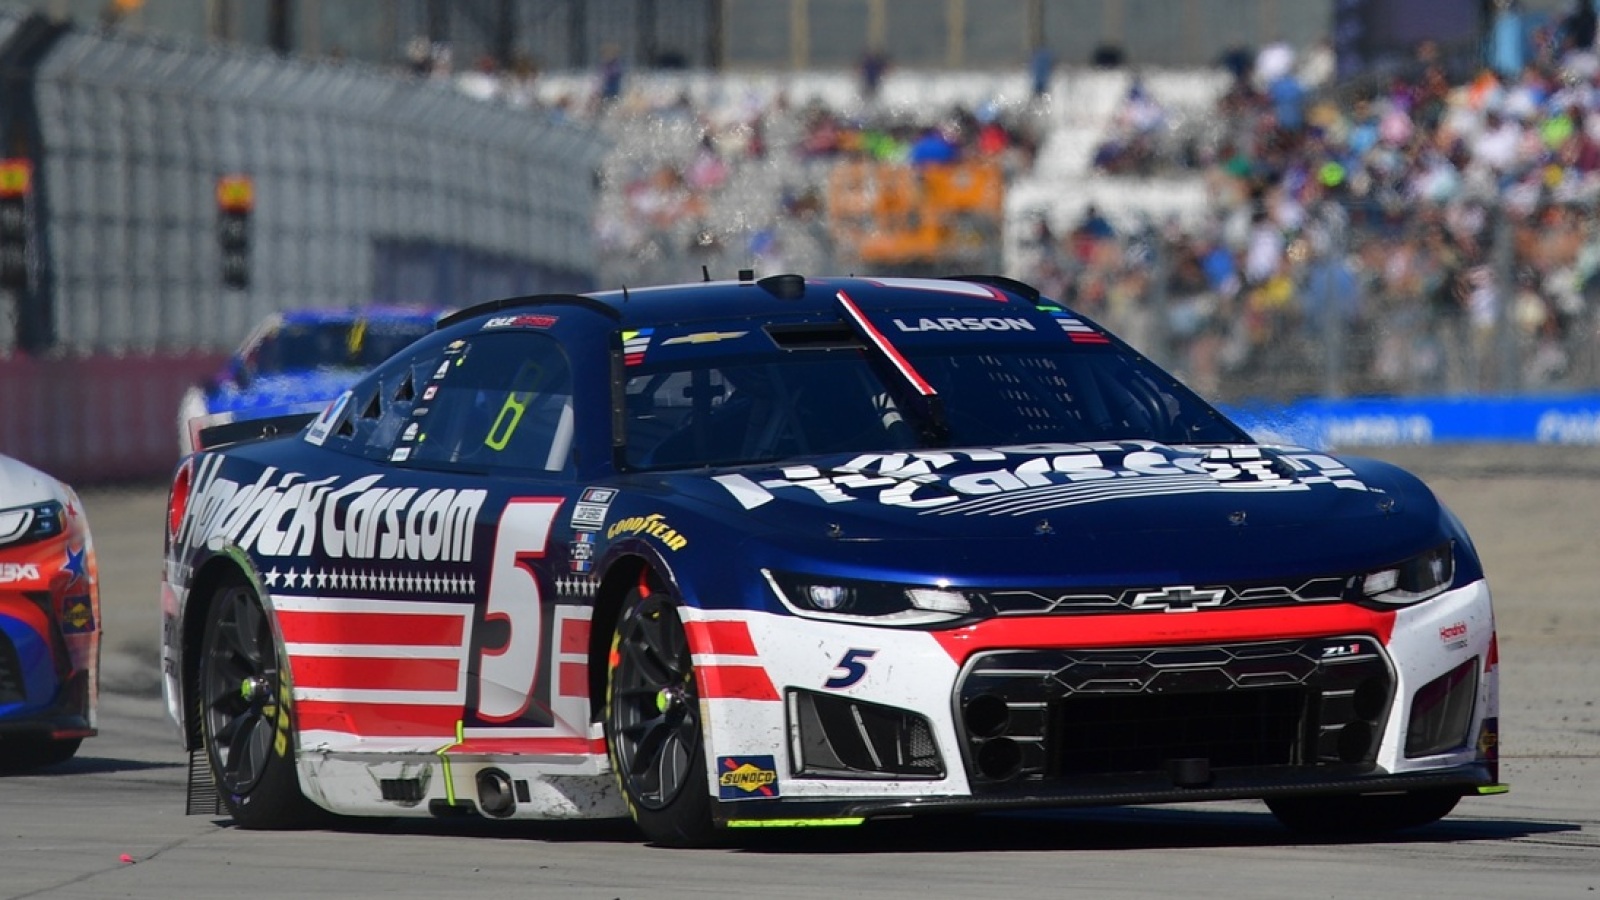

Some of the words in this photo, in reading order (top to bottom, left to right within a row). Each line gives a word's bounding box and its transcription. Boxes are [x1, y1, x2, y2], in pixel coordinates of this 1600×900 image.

[892, 318, 1037, 332] LARSON
[607, 513, 688, 551] GOODYEAR
[476, 496, 566, 723] 5
[1321, 643, 1360, 658] ZL1
[823, 648, 881, 690] 5
[721, 771, 776, 785] SUNOCO
